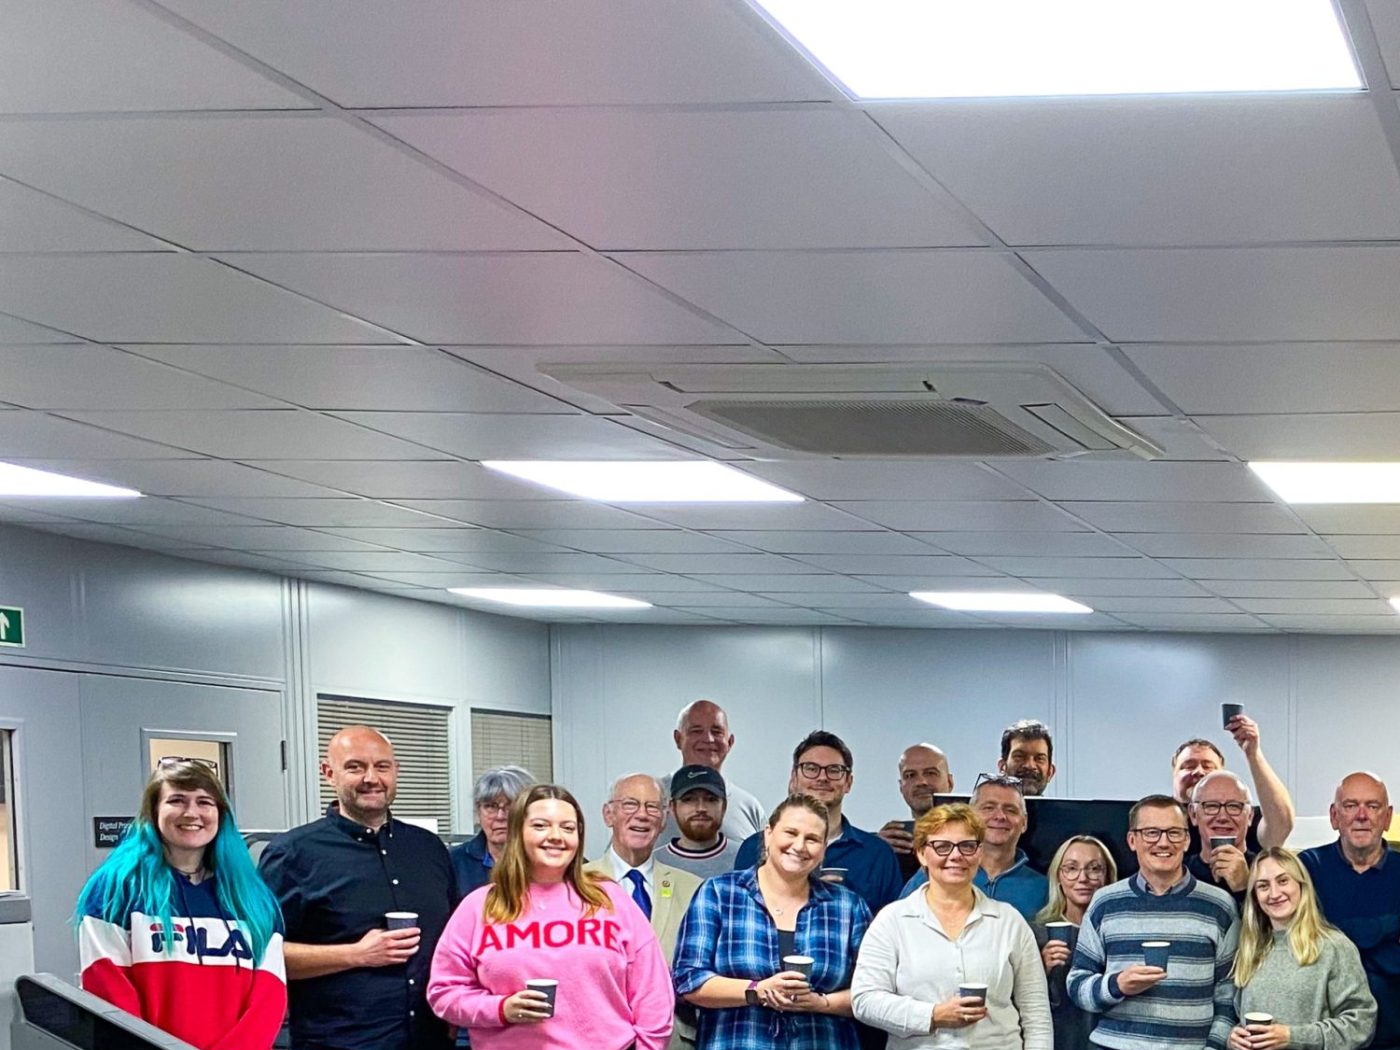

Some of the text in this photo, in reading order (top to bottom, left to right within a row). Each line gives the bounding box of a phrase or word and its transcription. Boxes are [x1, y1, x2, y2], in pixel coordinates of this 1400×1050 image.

[99, 822, 117, 831] Digital
[100, 833, 119, 842] Design
[149, 922, 254, 960] FILA
[476, 918, 621, 957] AMORE
